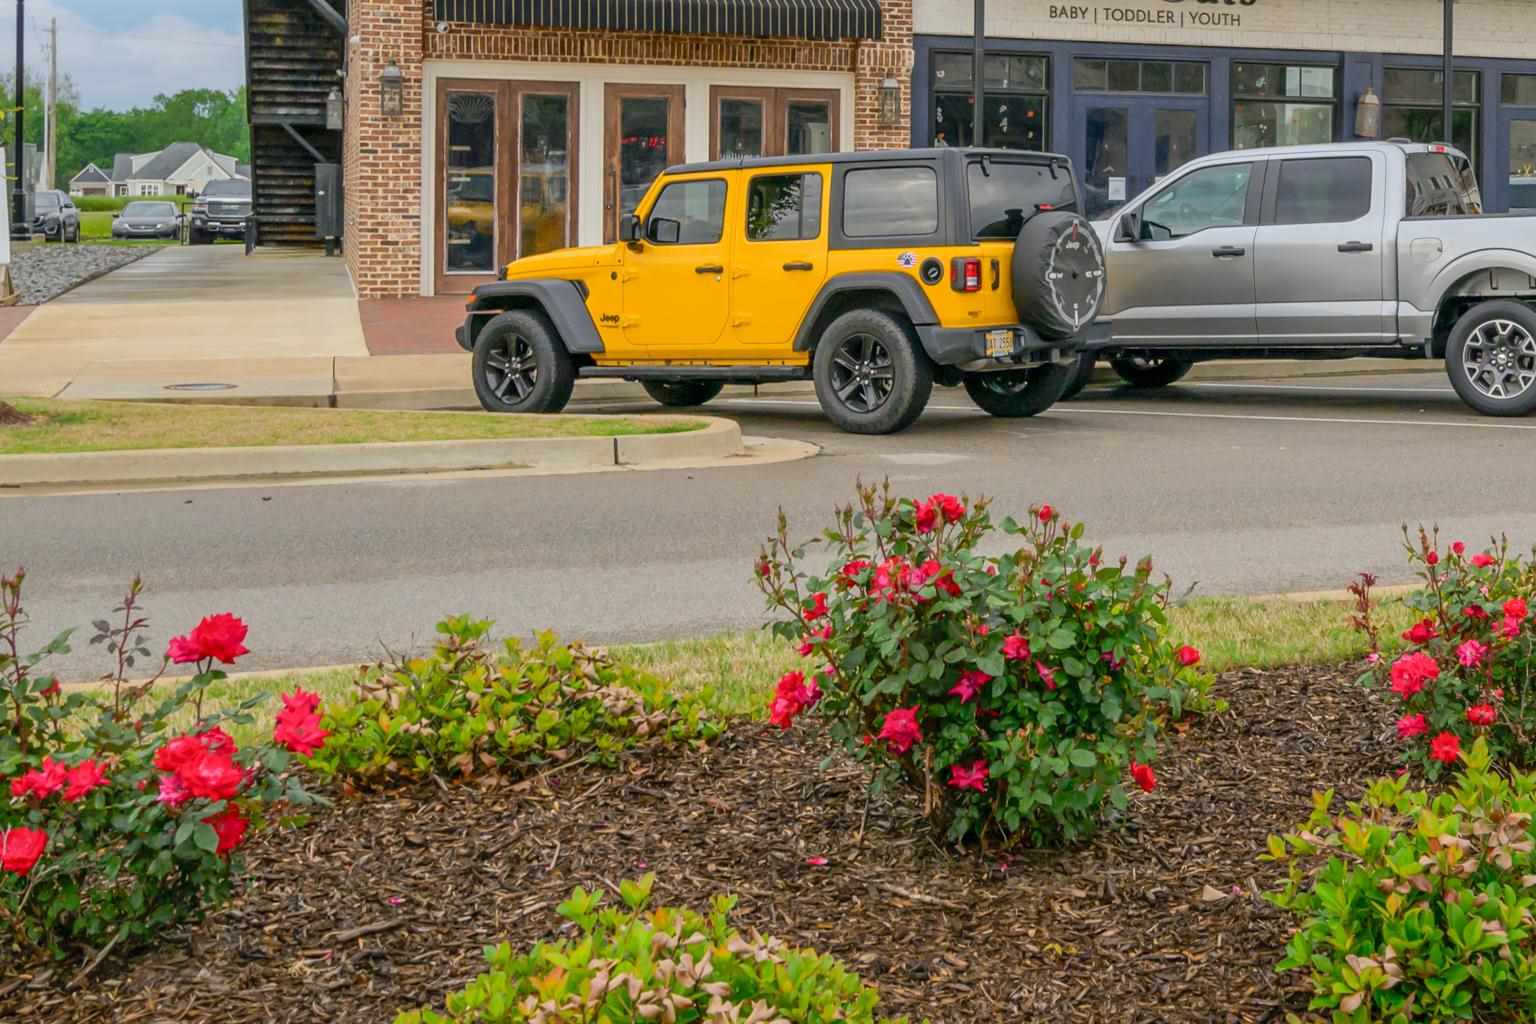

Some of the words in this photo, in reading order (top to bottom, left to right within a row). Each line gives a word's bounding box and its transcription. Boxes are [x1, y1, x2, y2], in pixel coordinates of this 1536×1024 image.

[1049, 4, 1089, 20] BABY
[1103, 7, 1176, 25] TODDLER
[1188, 11, 1241, 27] YOUTH
